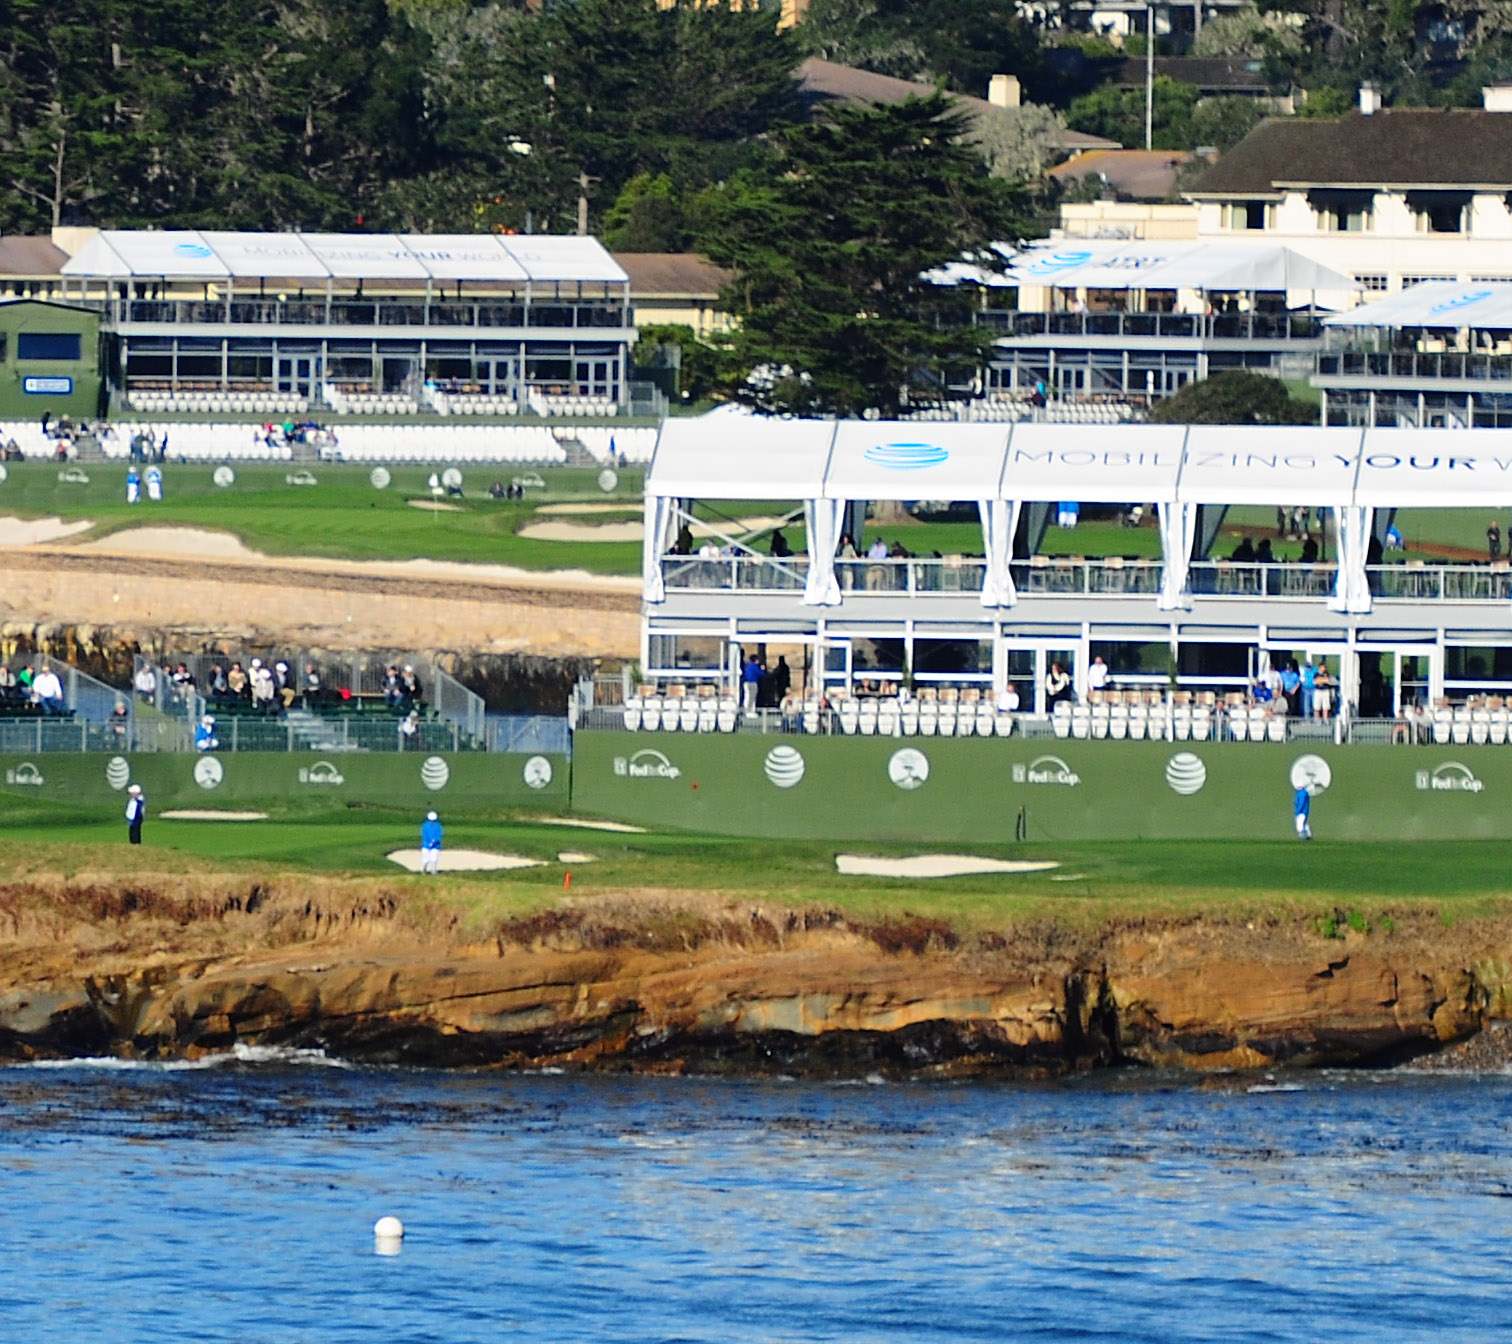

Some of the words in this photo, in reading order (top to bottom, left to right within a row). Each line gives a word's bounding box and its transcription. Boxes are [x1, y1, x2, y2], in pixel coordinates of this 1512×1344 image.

[386, 250, 454, 262] YOUR
[1014, 449, 1317, 468] MOBILIZING
[1334, 454, 1477, 471] YOUR
